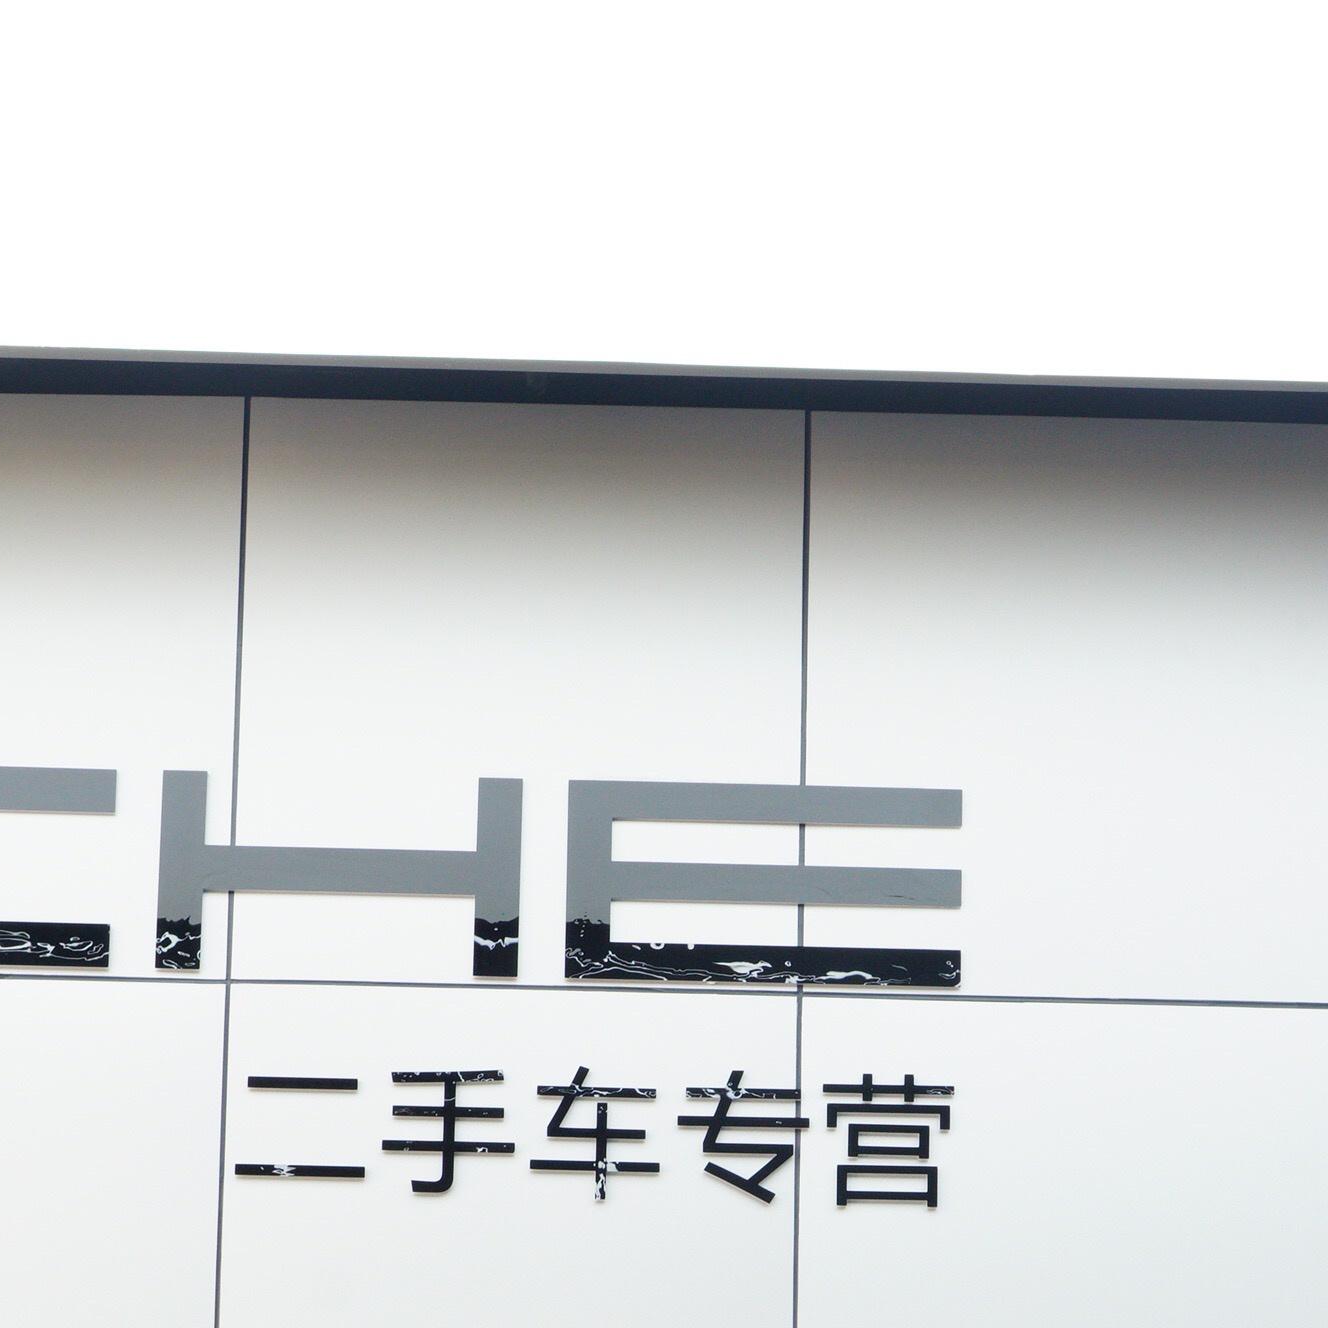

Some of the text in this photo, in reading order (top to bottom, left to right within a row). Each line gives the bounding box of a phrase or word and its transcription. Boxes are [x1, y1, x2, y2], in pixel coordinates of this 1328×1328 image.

[234, 1065, 955, 1208] 二手车专营
